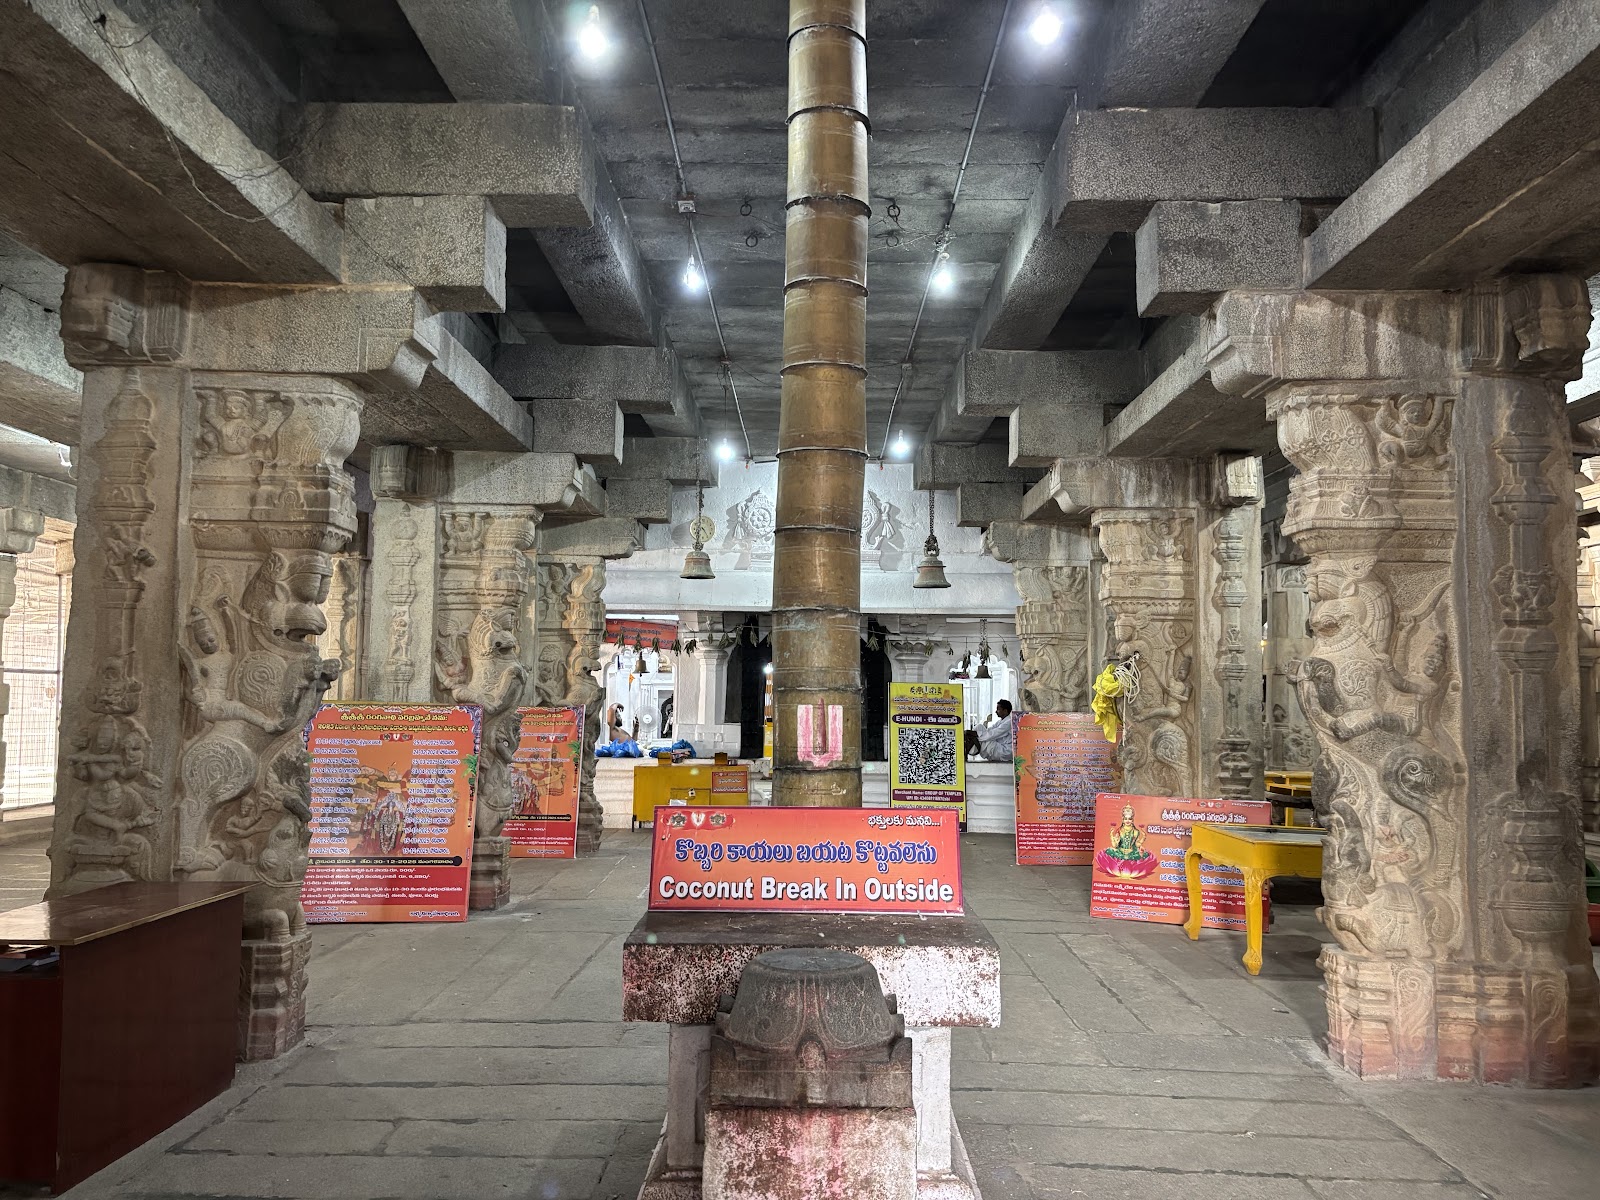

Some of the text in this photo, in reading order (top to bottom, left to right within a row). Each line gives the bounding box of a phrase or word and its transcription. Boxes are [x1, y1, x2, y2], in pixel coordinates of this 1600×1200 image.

[868, 815, 904, 829] భక్తులకు
[675, 838, 724, 871] కొబ్బరి
[727, 840, 793, 862] కాయలు
[796, 840, 852, 863] బయట
[659, 876, 954, 902] Coconut Break In Outside
